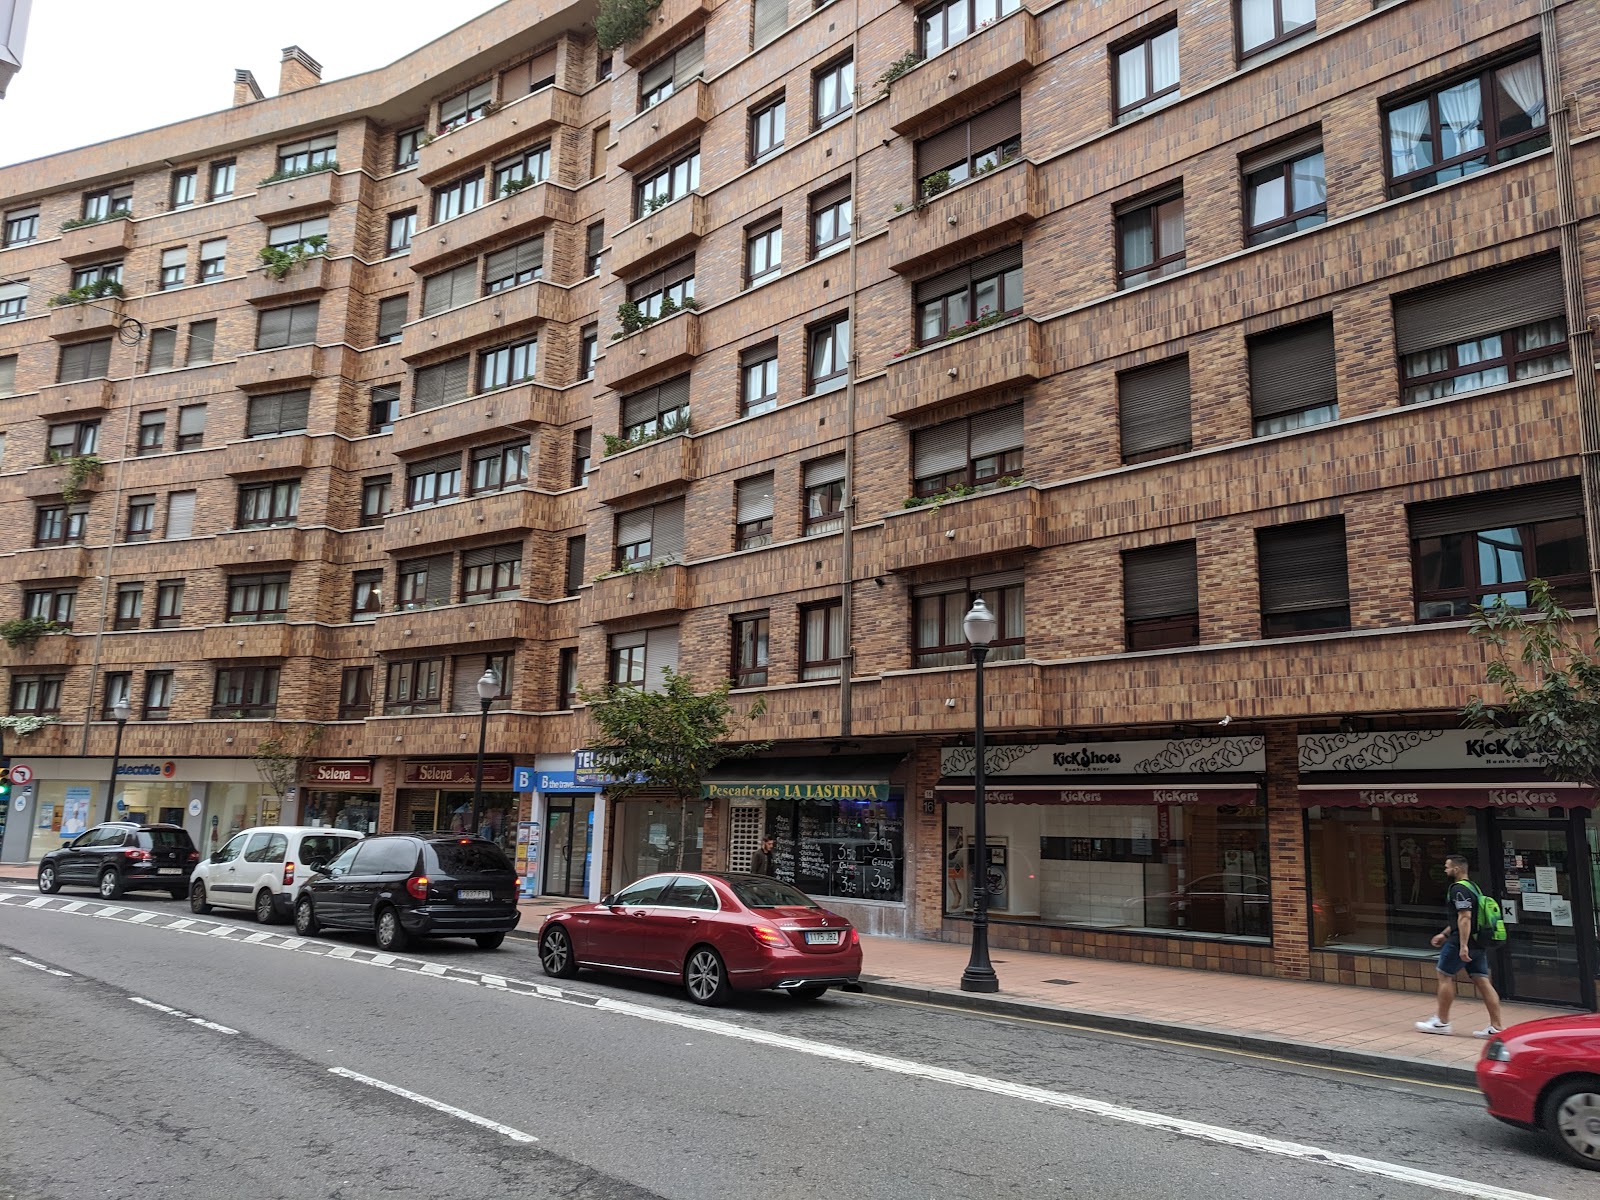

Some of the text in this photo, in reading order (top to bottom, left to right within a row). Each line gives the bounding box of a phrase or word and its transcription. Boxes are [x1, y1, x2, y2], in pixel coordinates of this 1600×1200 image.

[115, 764, 160, 776] elecable
[317, 765, 350, 781] Selena
[419, 765, 452, 781] Selena
[519, 771, 529, 788] B
[541, 775, 549, 789] B
[549, 780, 559, 788] the
[709, 784, 877, 798] Pescaderías LA LASTRINA
[984, 792, 1014, 801] icKers
[924, 801, 934, 812] 16
[1504, 907, 1513, 916] K
[810, 932, 825, 941] 1175
